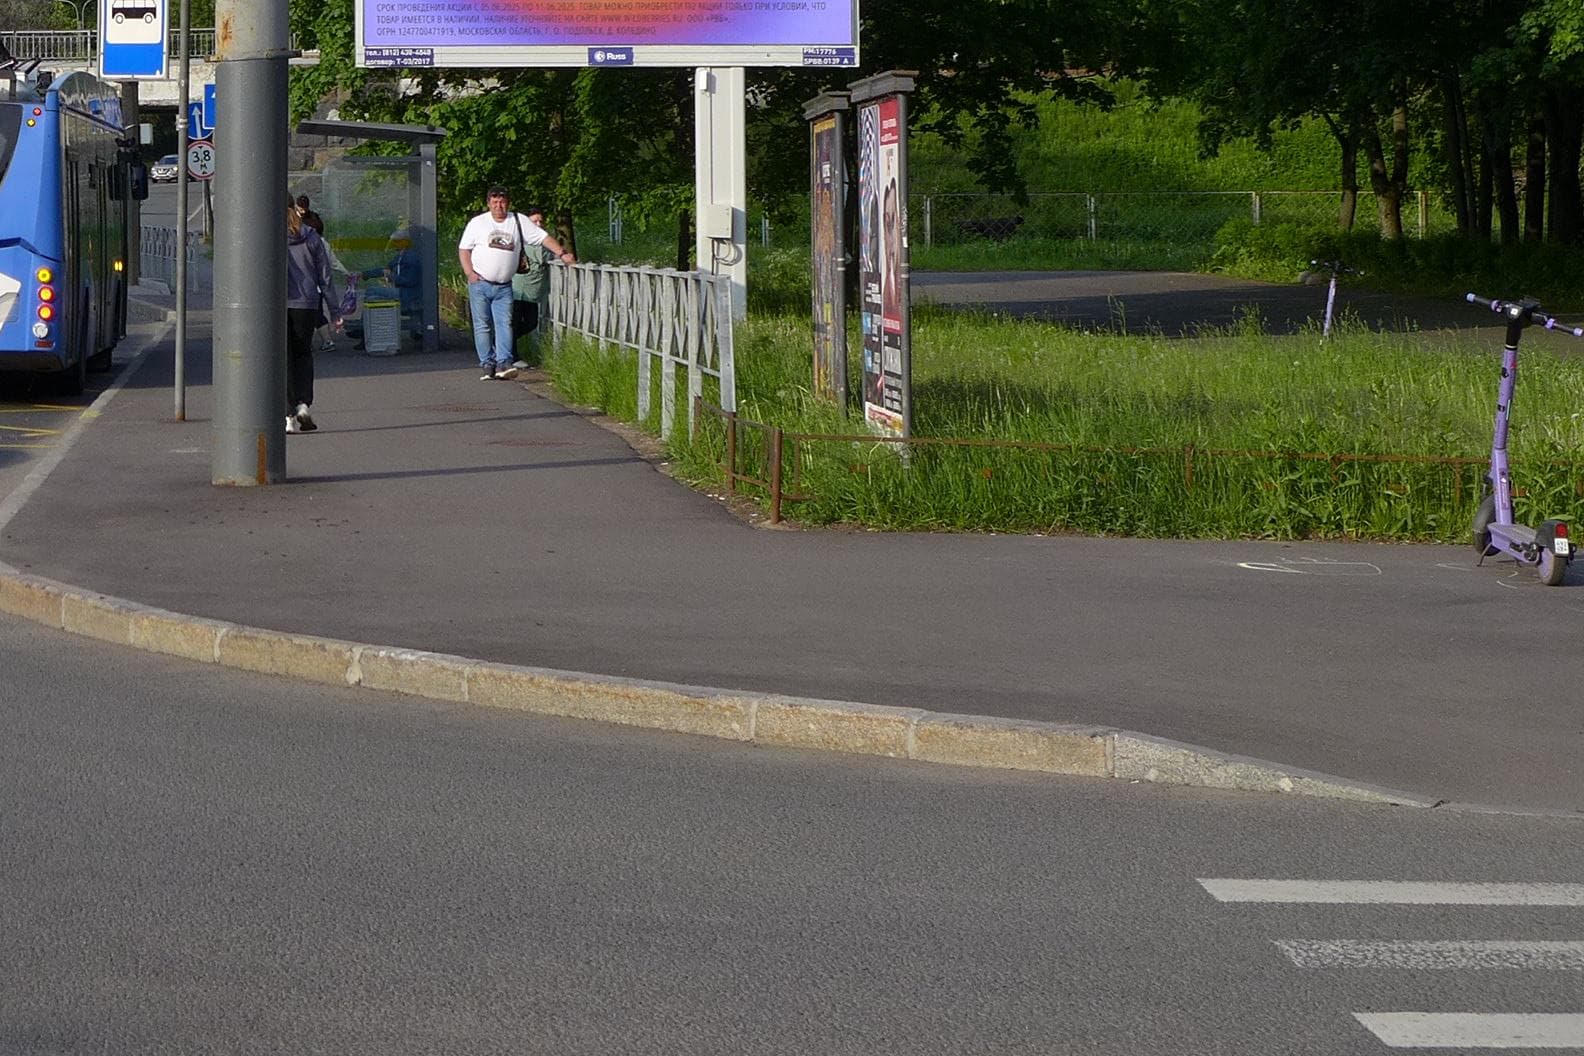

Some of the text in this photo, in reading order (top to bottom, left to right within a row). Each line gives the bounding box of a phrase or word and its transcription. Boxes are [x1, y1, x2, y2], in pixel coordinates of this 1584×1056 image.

[811, 2, 827, 10] ЧТО
[376, 15, 399, 24] ТОВАР
[401, 15, 435, 24] ИМЕЕТСЯ
[606, 52, 627, 61] Russ
